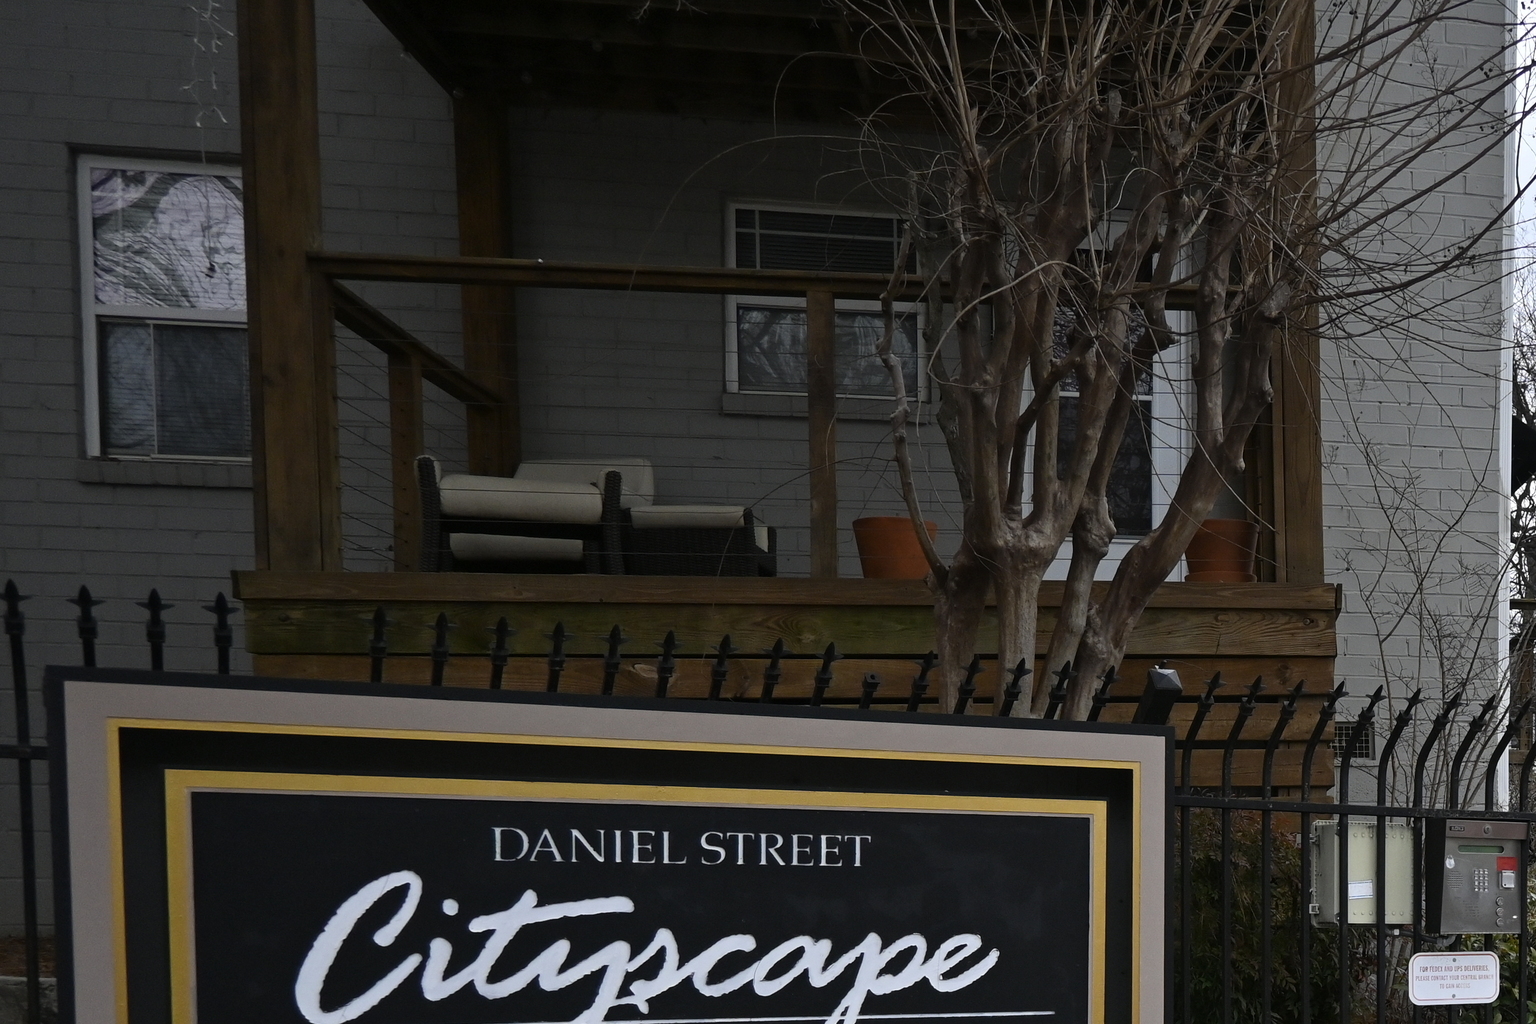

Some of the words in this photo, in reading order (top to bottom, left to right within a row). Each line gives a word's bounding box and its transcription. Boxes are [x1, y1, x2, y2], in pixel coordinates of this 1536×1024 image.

[491, 826, 686, 865] DANIEL
[700, 831, 872, 867] STREET
[1429, 965, 1443, 973] FEDEX
